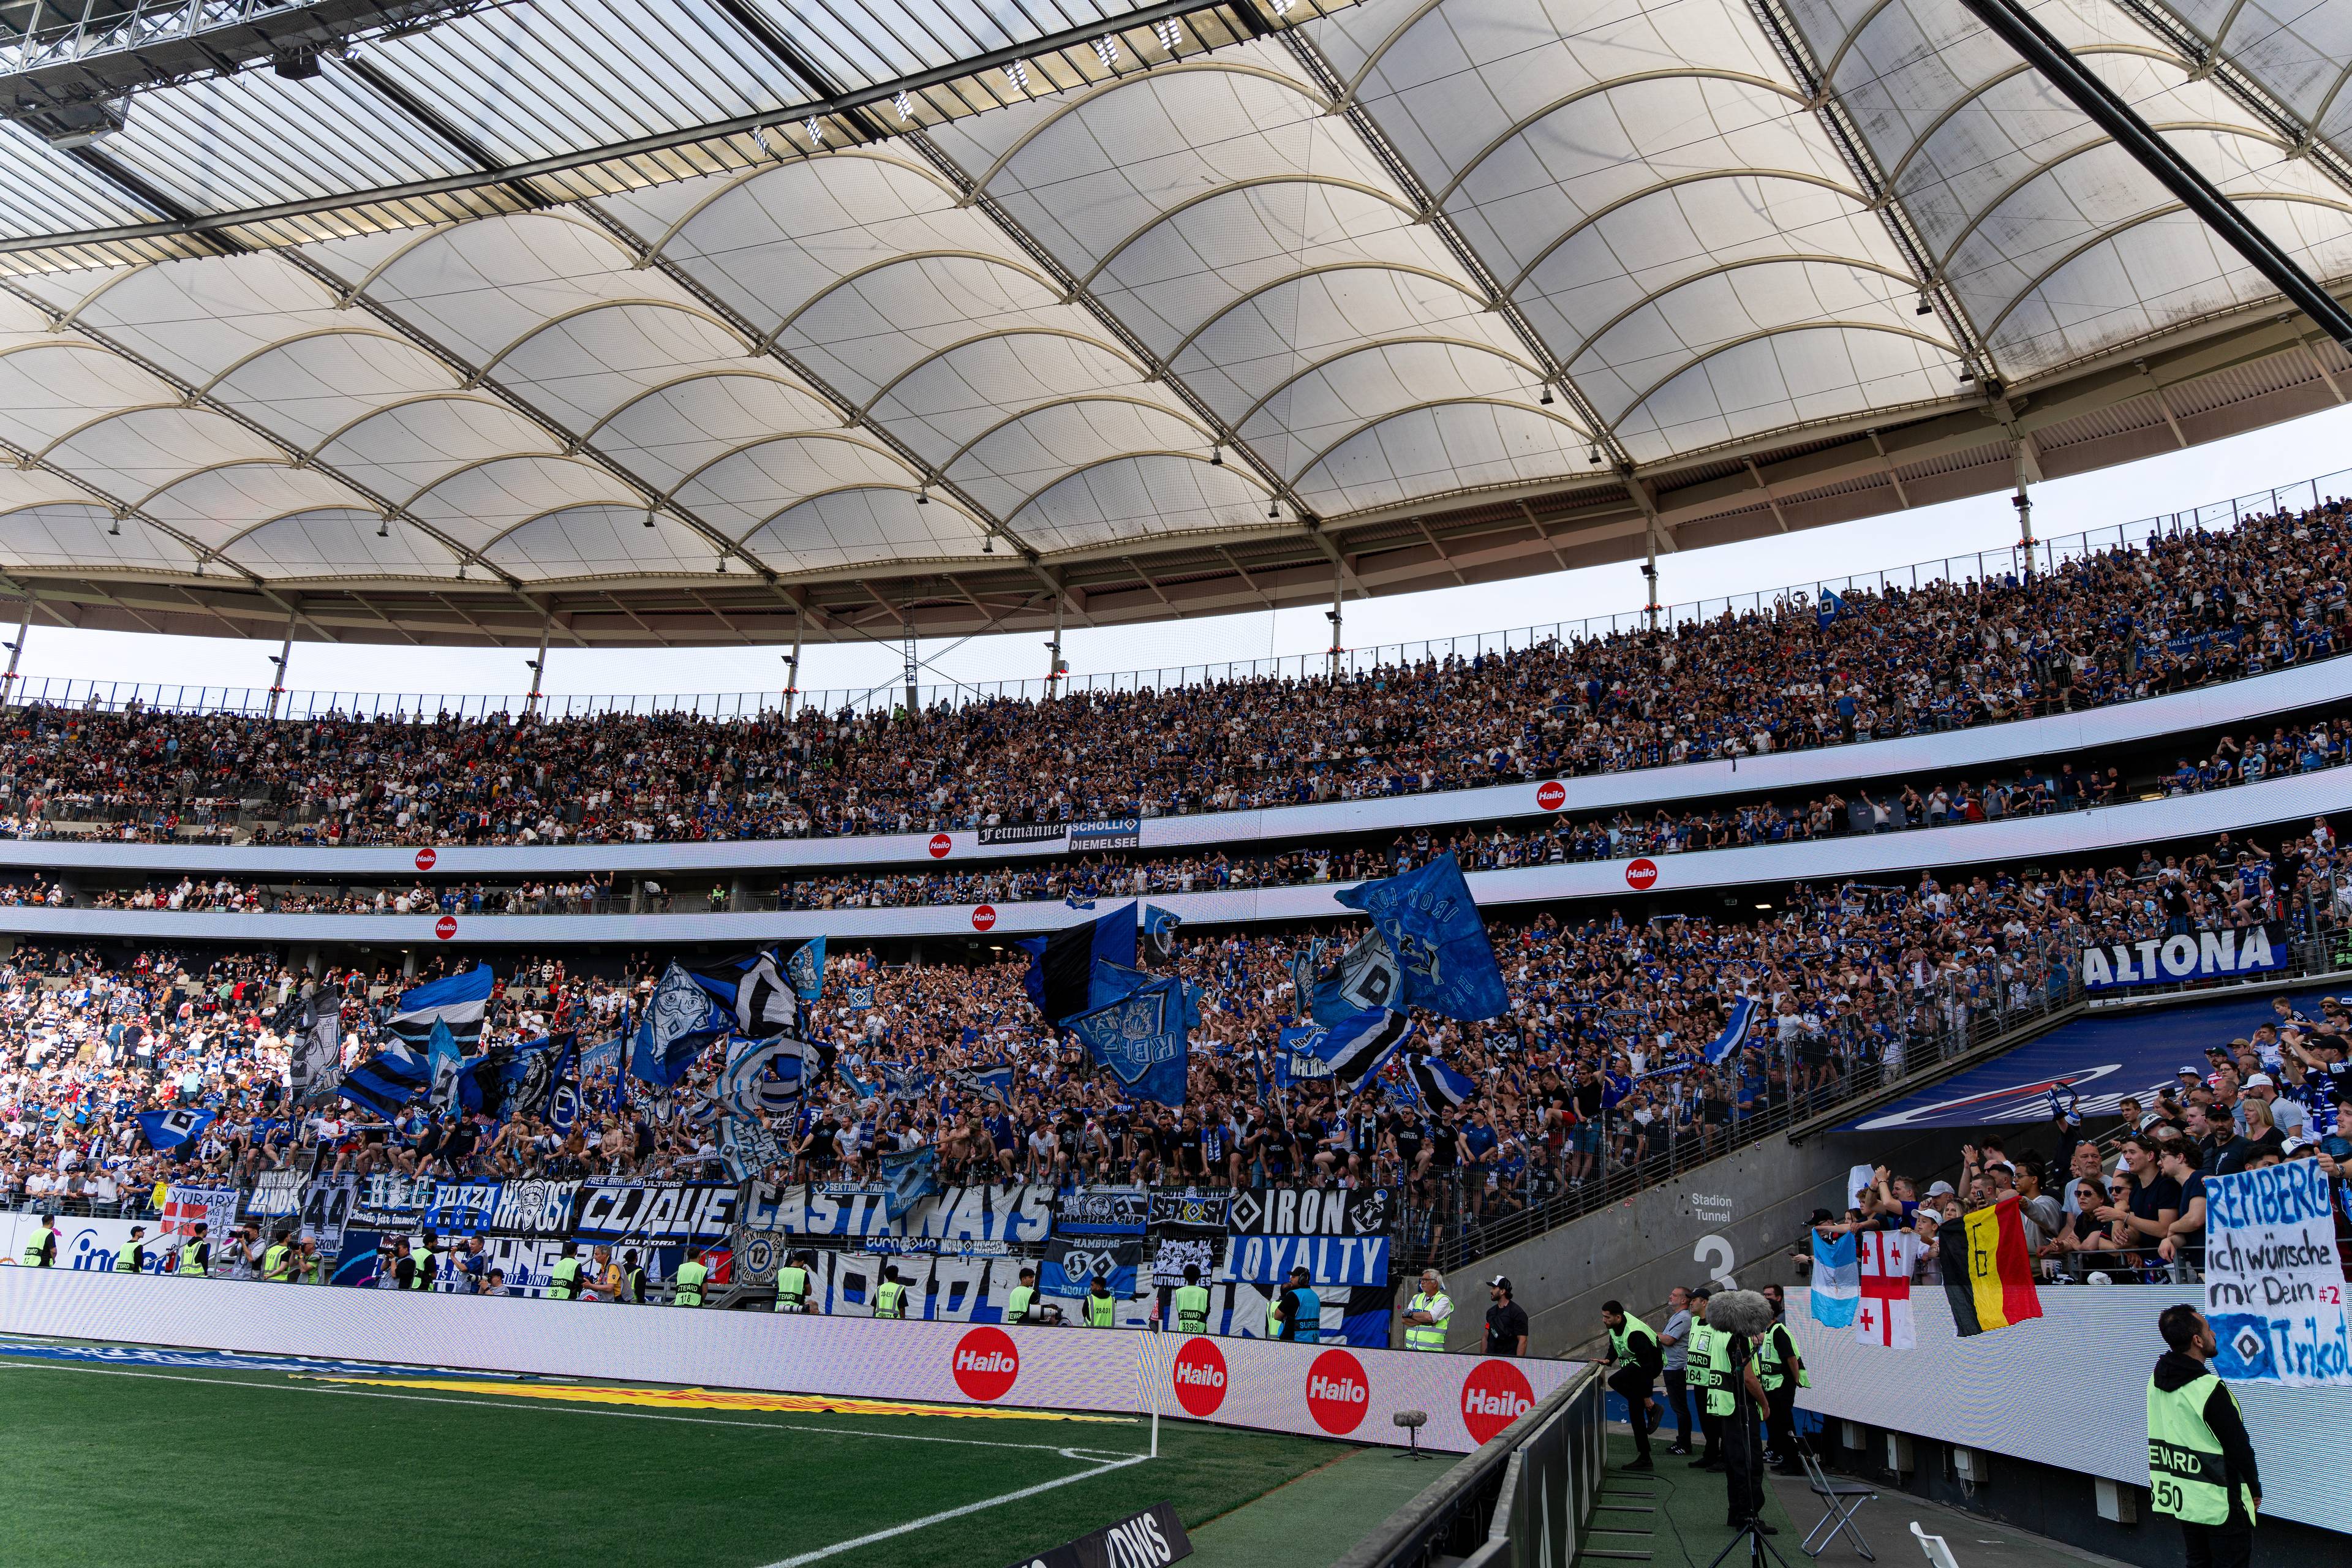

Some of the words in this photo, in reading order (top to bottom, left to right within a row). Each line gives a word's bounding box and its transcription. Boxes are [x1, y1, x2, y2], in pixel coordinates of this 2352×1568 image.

[1539, 790, 1564, 801] Hailo
[1072, 820, 1123, 832] SCHOLLI
[1071, 837, 1137, 850] DIEMELSEE
[1627, 869, 1656, 878] Hailo
[2083, 925, 2274, 986] ALTONA
[1291, 1027, 1330, 1048] HAMBUR
[587, 1177, 605, 1185] FREE
[172, 1191, 236, 1208] YURARY
[1692, 1193, 1732, 1207] Stadion
[2205, 1158, 2332, 1234] REMBERG
[579, 1188, 739, 1236] CLIQUE
[1057, 1212, 1115, 1226] HAMBURG
[1262, 1189, 1348, 1234] IRON
[1695, 1208, 1731, 1223] Tunnel
[427, 1216, 488, 1227] HAMBURG
[940, 1239, 962, 1253] NORD
[1072, 1238, 1120, 1248] HAMBURG
[2209, 1232, 2244, 1273] ich
[2245, 1228, 2332, 1270] wünsche
[752, 1246, 766, 1264] 12
[1224, 1235, 1383, 1284] LOYALTY
[1694, 1234, 1738, 1291] 3
[2209, 1272, 2256, 1308] mir
[2262, 1273, 2315, 1306] Dein
[2319, 1286, 2340, 1305] #2
[1182, 1322, 1197, 1332] 3396
[956, 1349, 1015, 1373] Hailo
[1176, 1361, 1224, 1387] Hailo
[1310, 1375, 1366, 1403] Hailo
[1465, 1388, 1531, 1417] Hailo
[2149, 1445, 2201, 1474] EWARD
